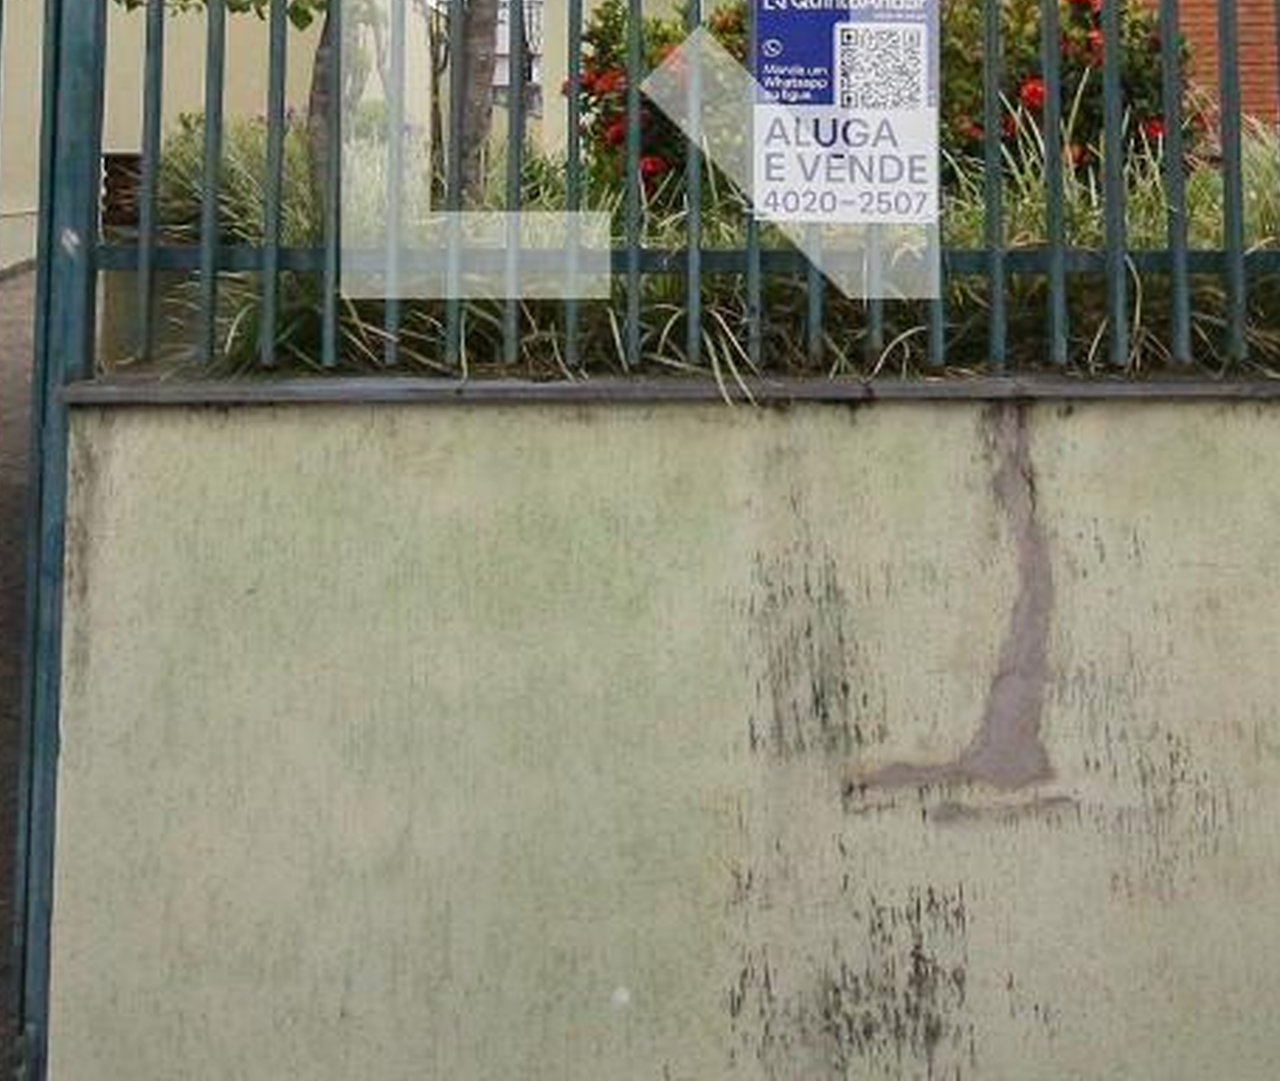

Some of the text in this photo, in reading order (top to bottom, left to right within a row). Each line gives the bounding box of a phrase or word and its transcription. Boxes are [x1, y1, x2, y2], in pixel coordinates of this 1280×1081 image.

[765, 118, 898, 147] ALUGA
[765, 153, 929, 183] E VENDE
[764, 190, 927, 215] 4020-2507
